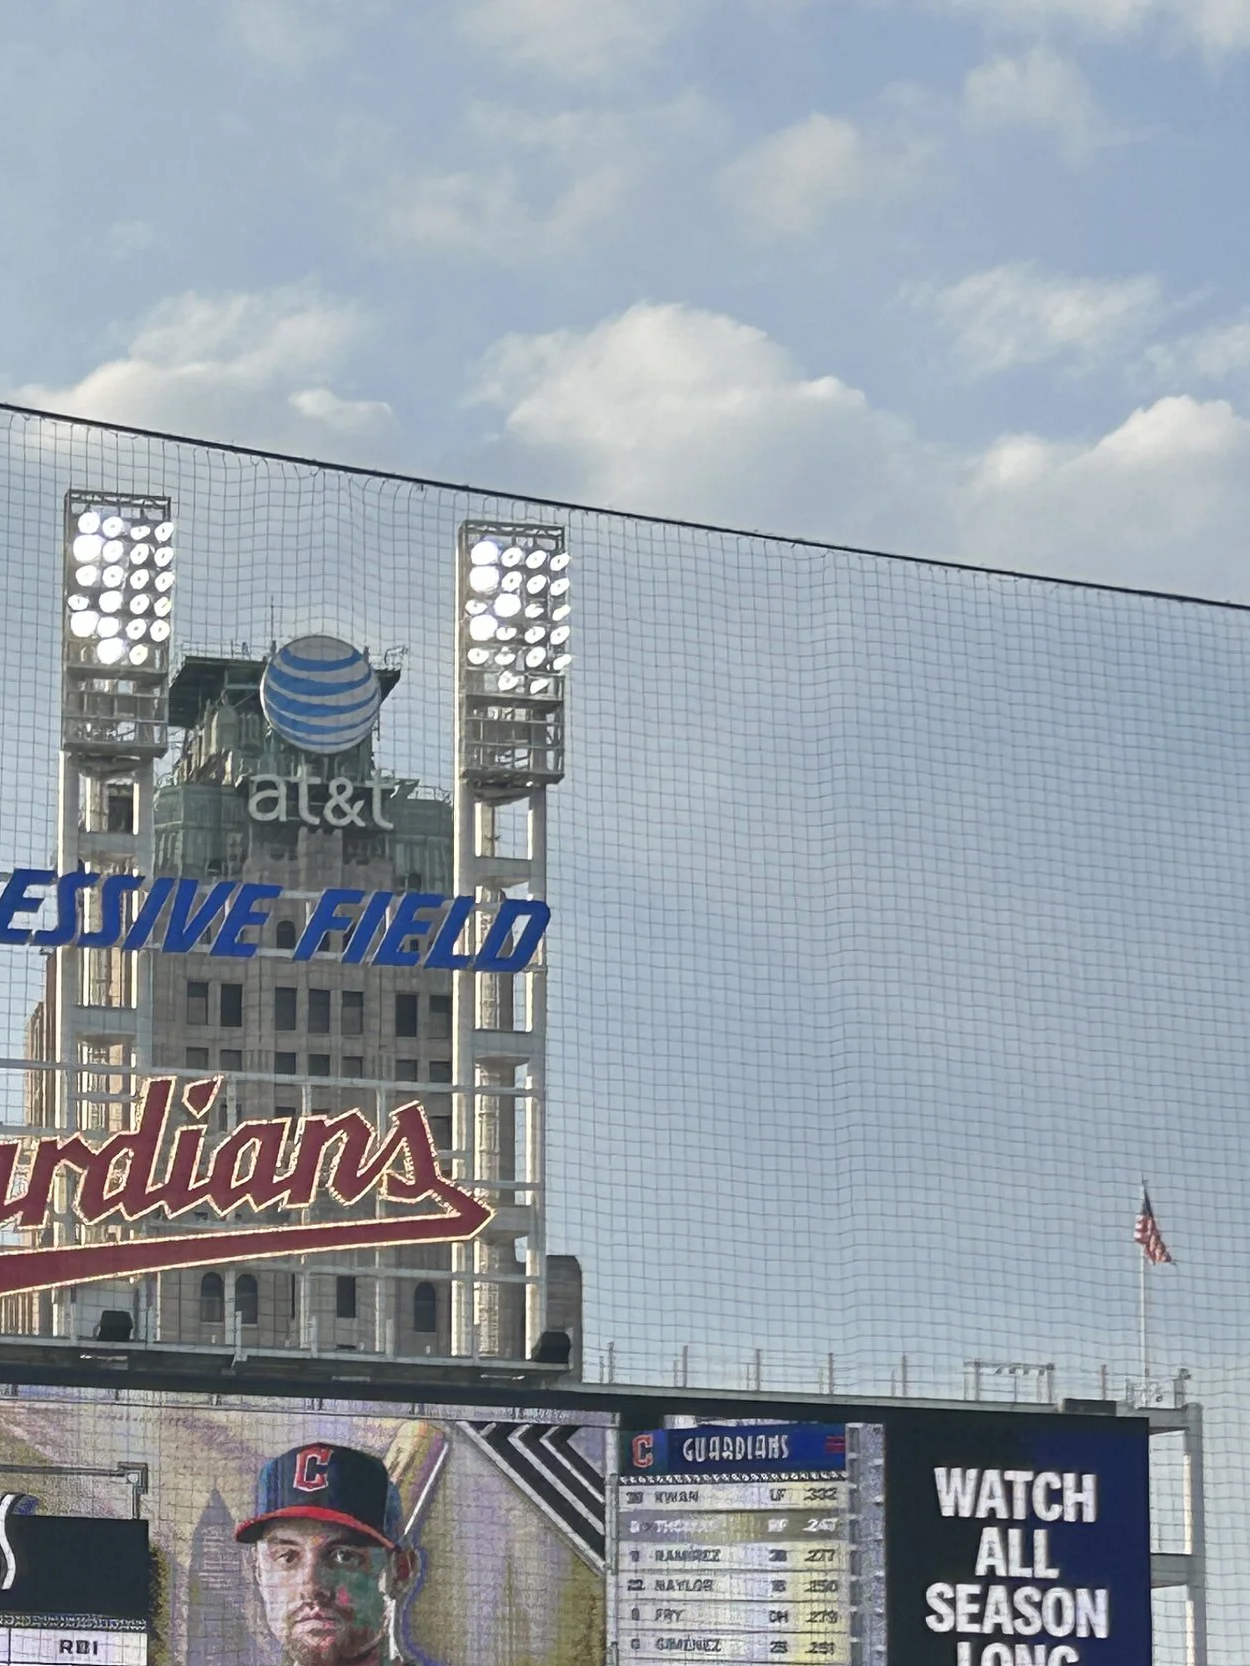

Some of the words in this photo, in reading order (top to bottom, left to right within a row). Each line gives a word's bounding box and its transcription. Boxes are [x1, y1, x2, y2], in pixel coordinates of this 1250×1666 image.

[247, 773, 393, 829] at&t
[292, 889, 551, 973] FIELD
[933, 1466, 1099, 1524] WATCH
[975, 1526, 1061, 1579] ALL
[925, 1581, 1111, 1640] SEASON
[59, 1639, 98, 1657] RBI
